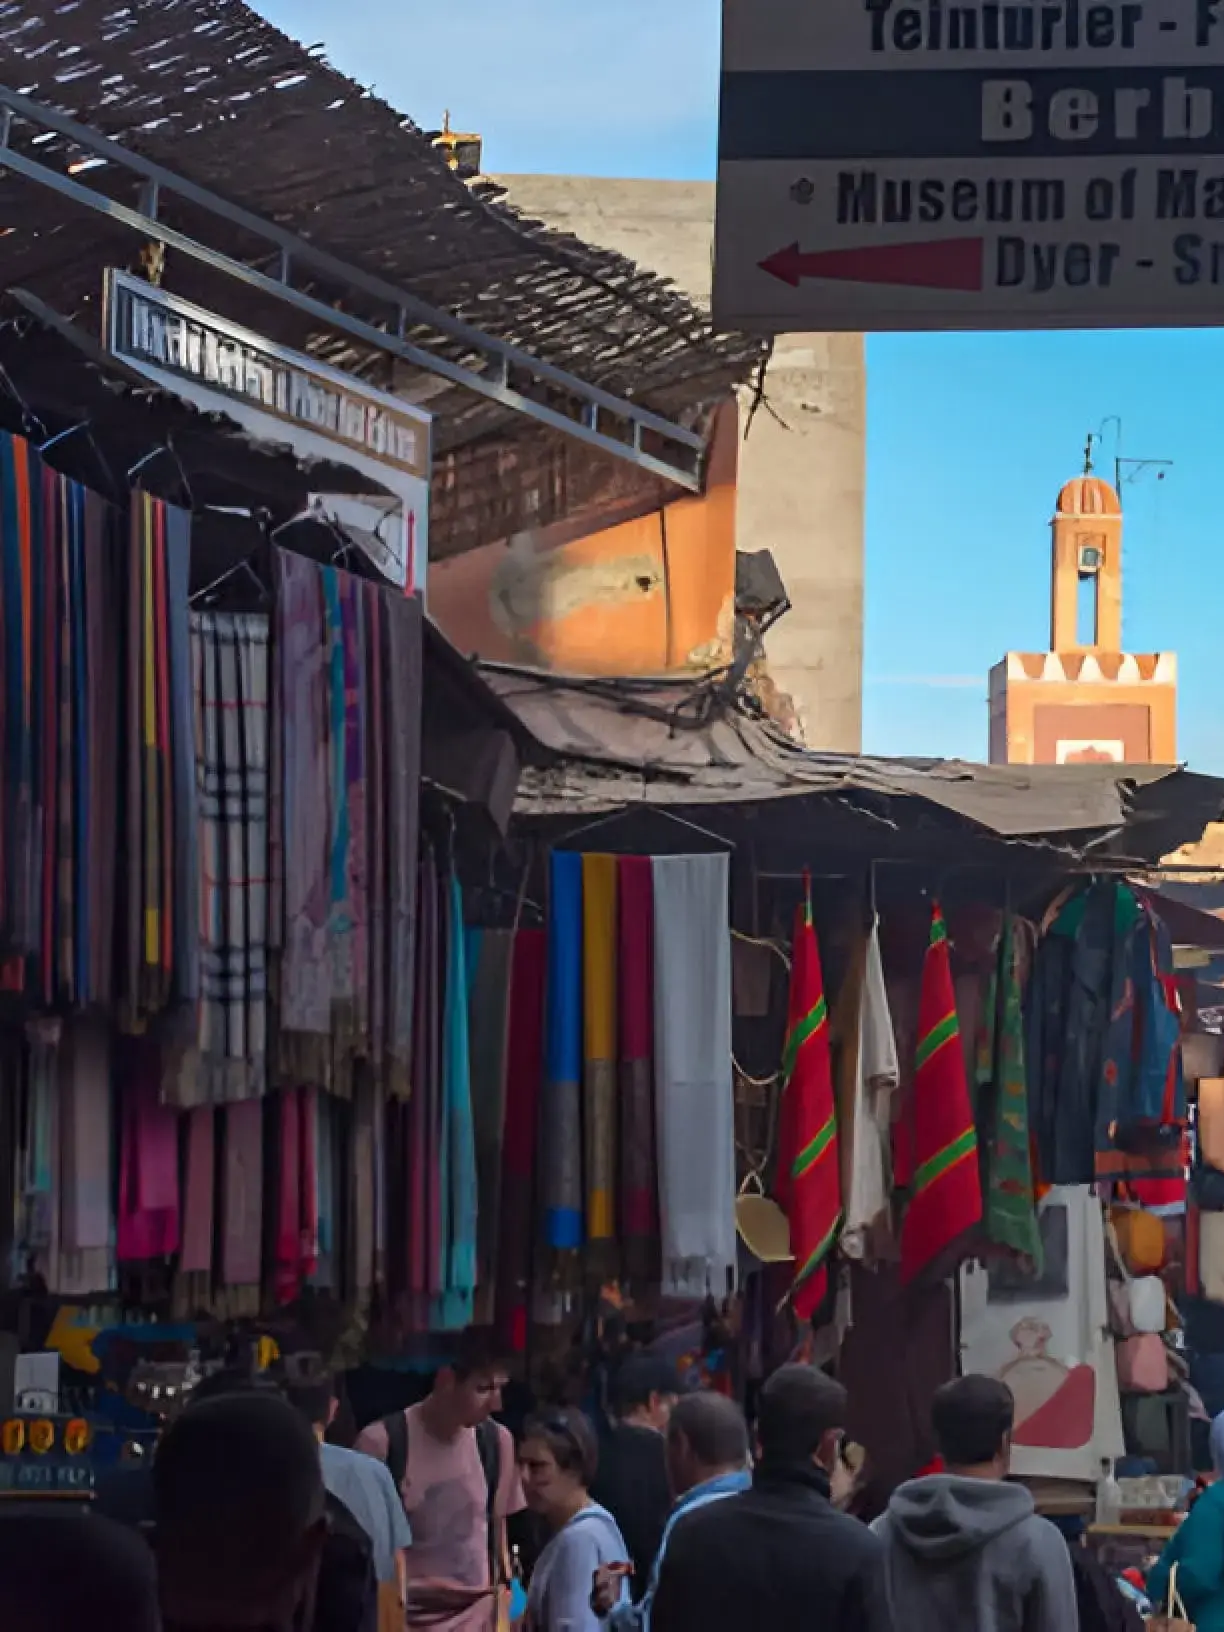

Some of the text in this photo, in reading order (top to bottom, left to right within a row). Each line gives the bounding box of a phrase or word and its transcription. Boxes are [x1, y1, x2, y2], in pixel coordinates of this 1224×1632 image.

[865, 0, 1142, 51] Teinturier
[836, 170, 1064, 225] Museum
[1086, 168, 1136, 221] of
[996, 236, 1120, 292] Dyer
